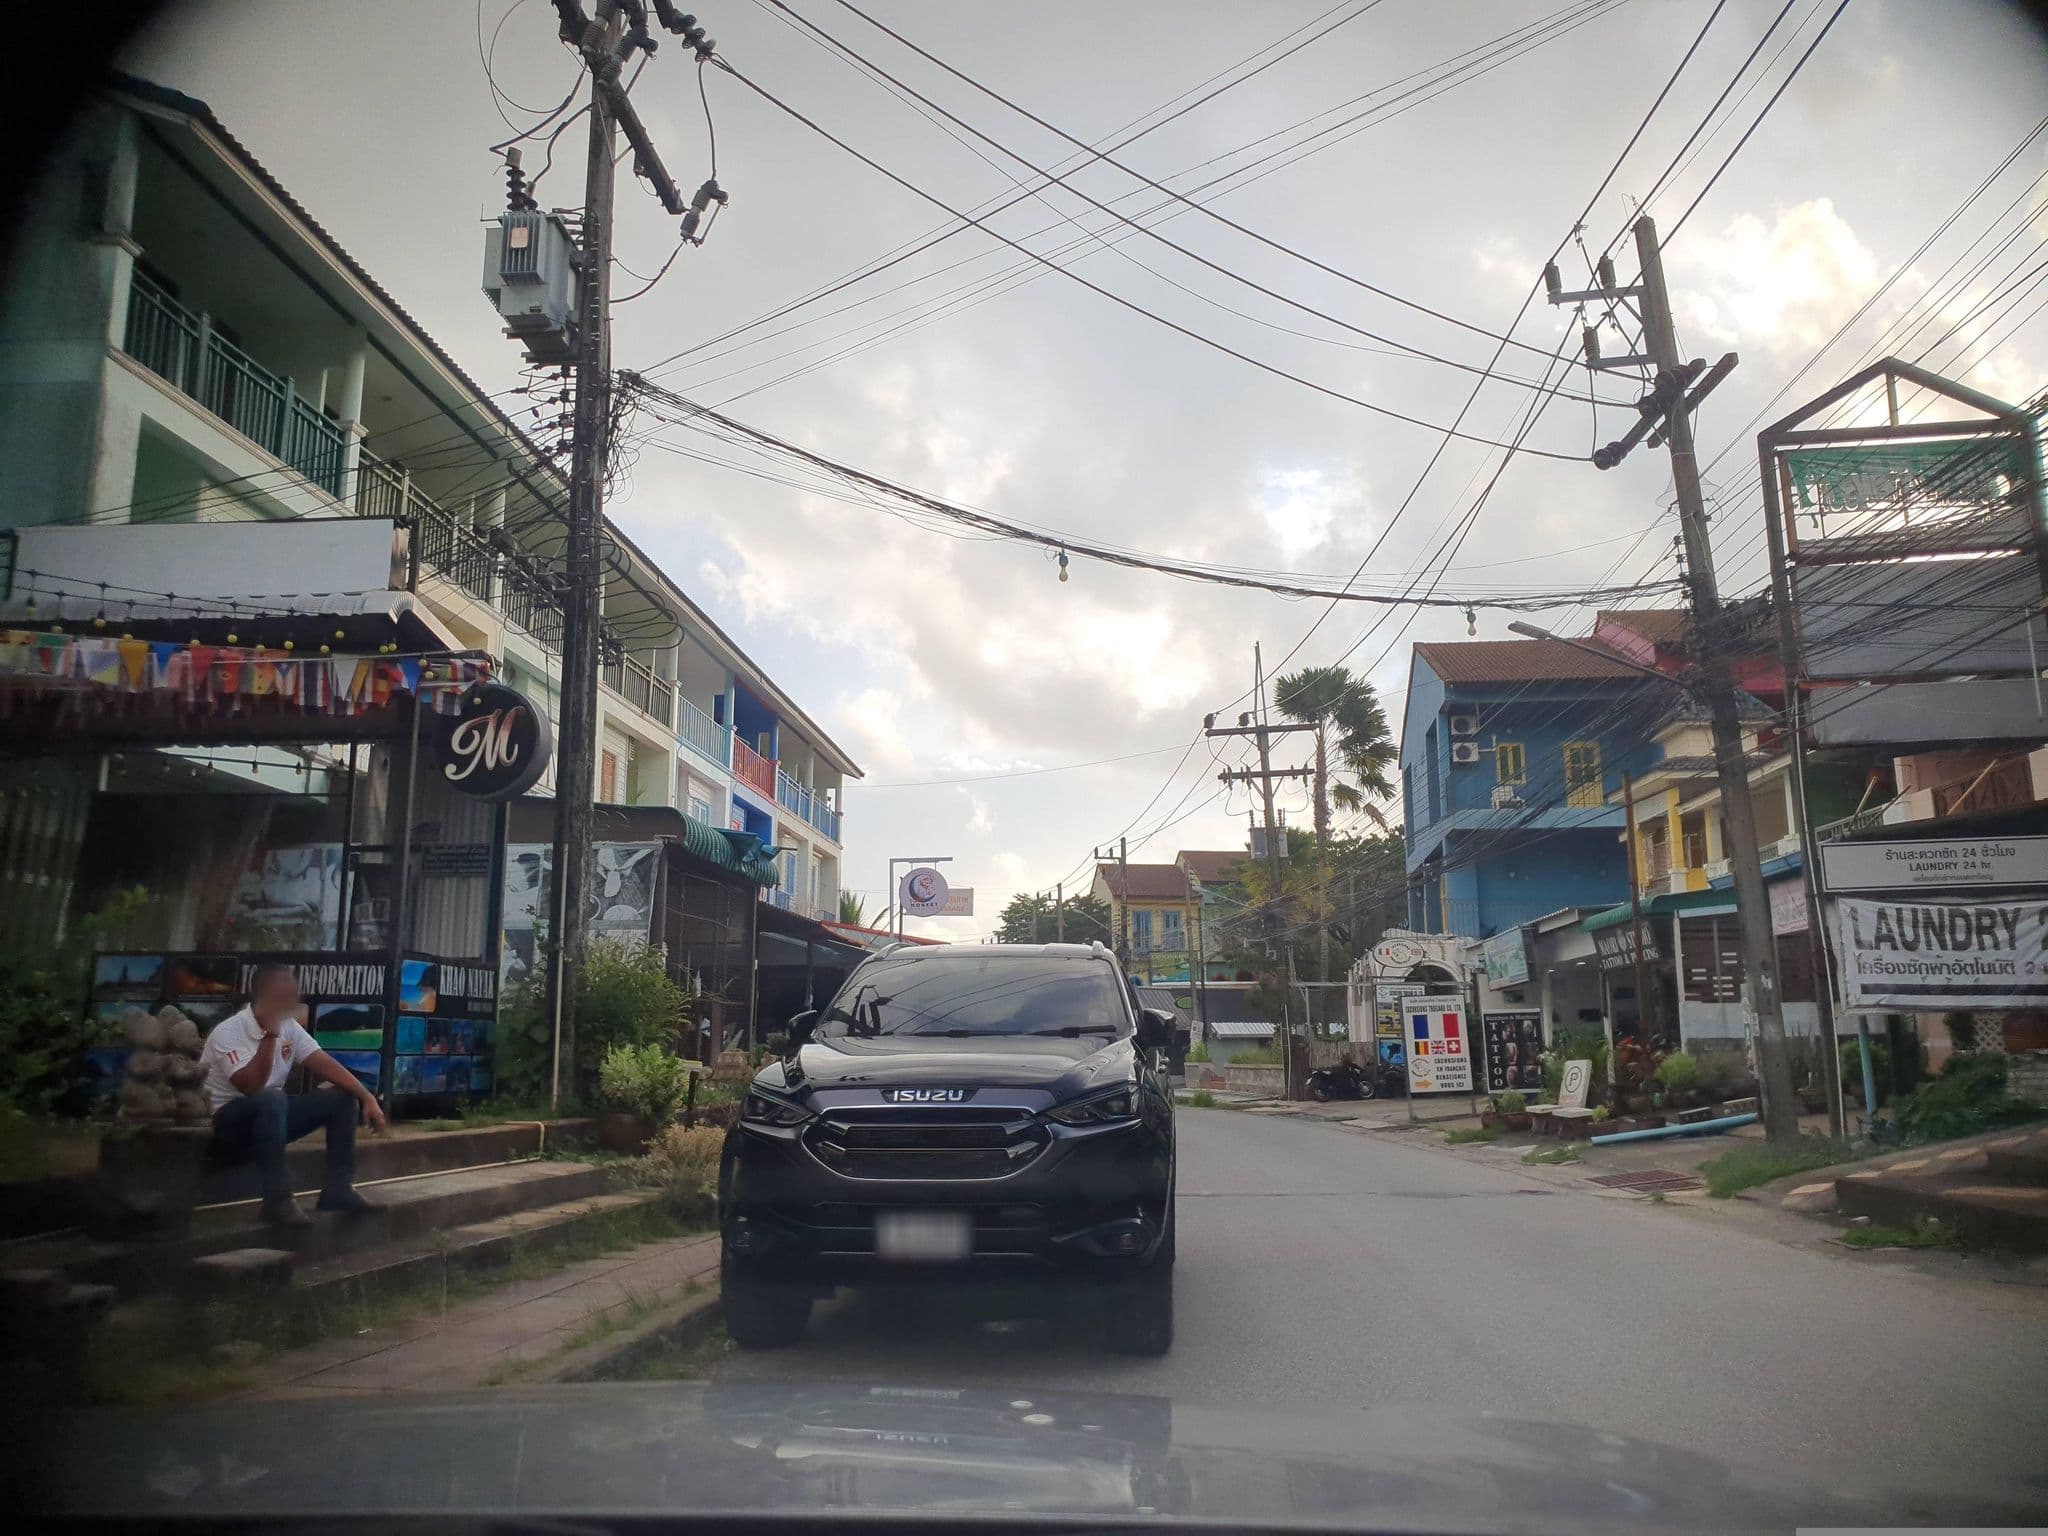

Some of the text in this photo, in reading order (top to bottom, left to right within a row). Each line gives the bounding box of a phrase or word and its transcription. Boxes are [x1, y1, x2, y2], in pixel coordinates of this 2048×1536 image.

[1909, 862, 1958, 872] LAUNDRY
[1963, 861, 1977, 870] 24
[1962, 848, 1977, 858] 24
[1850, 906, 2022, 951] LAUNDRY
[300, 965, 386, 996] INFORMATION
[439, 965, 465, 997] KHAO
[1489, 1022, 1503, 1087] TATTOO
[893, 1090, 964, 1102] ISUZU
